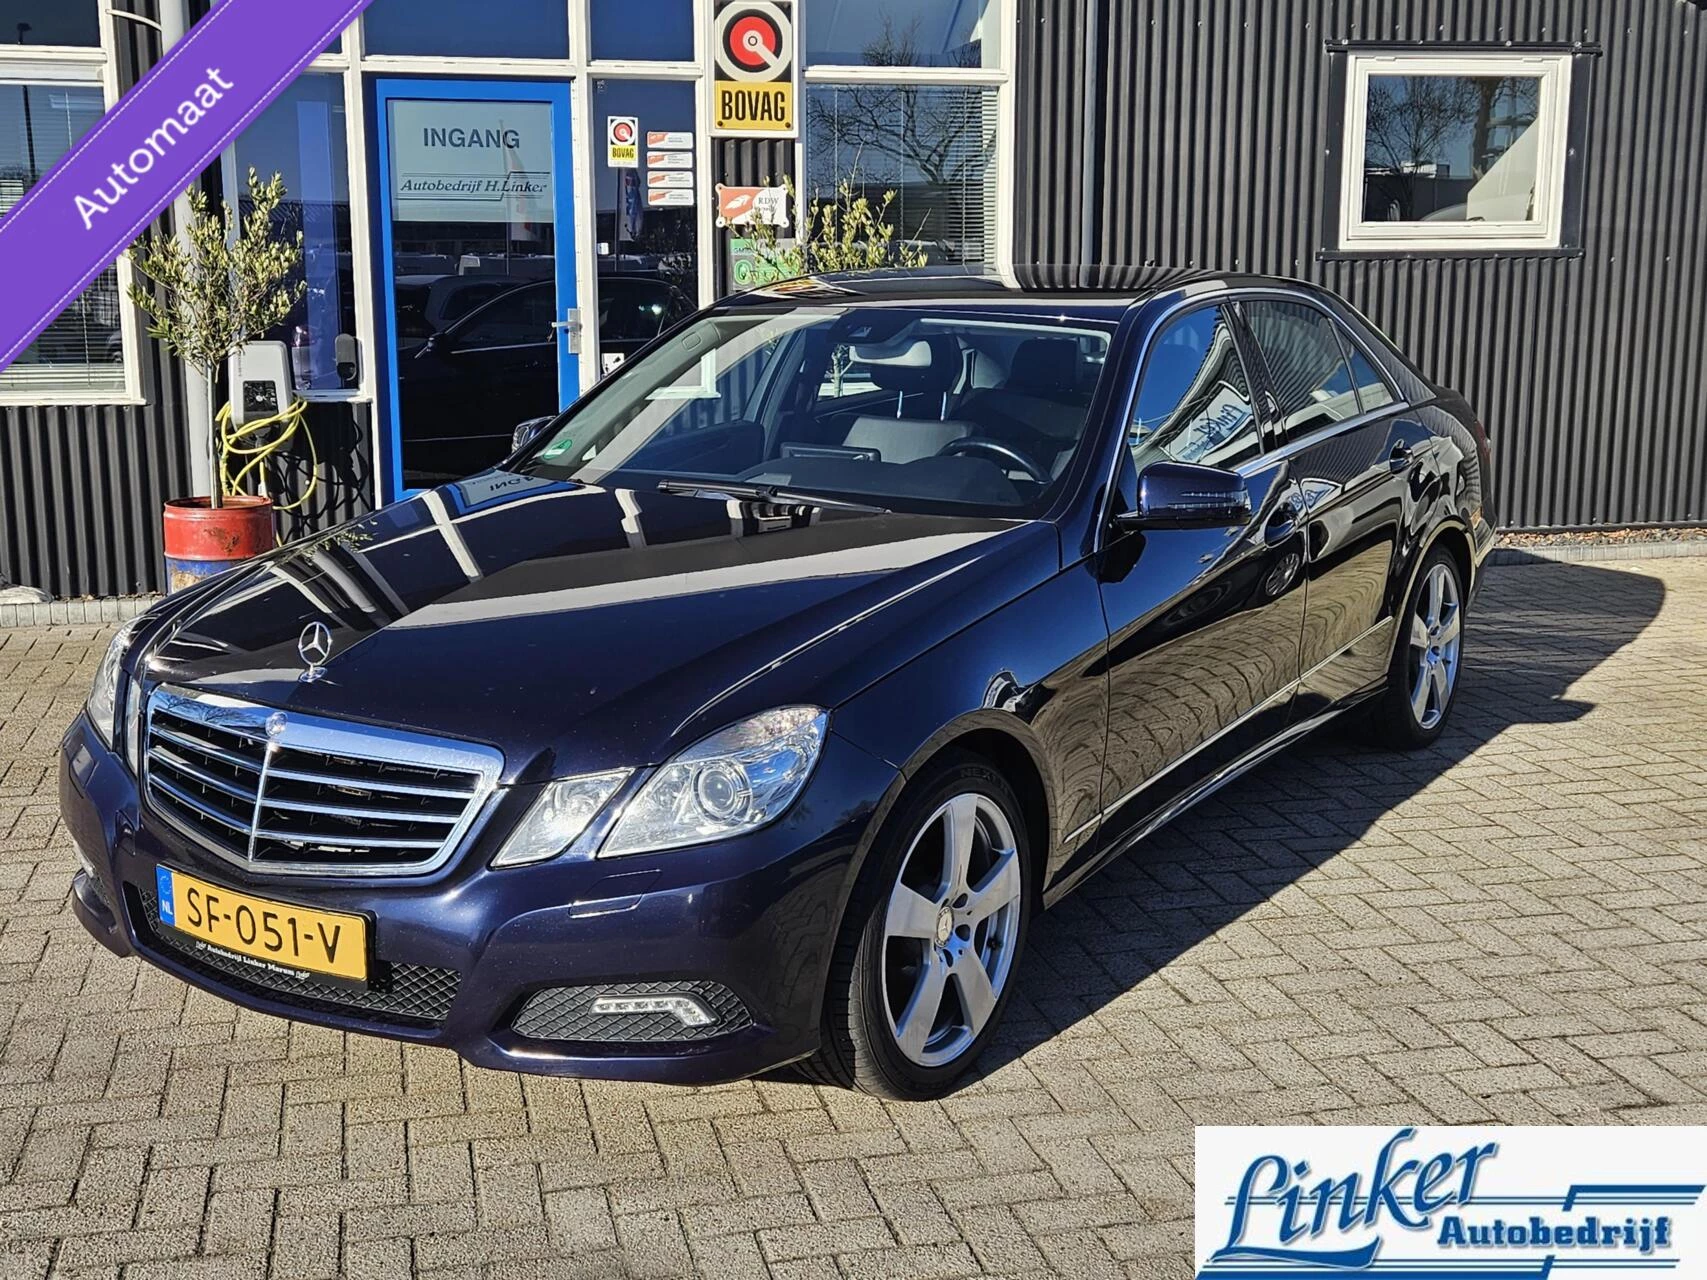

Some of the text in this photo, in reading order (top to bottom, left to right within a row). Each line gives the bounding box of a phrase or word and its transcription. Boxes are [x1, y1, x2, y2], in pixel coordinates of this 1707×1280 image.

[721, 90, 786, 122] BOVAG
[423, 127, 520, 149] INGANG
[612, 147, 634, 158] BOVAG
[400, 179, 483, 192] Autobedrijf
[161, 900, 173, 915] NL
[187, 887, 341, 964] SF-051-V
